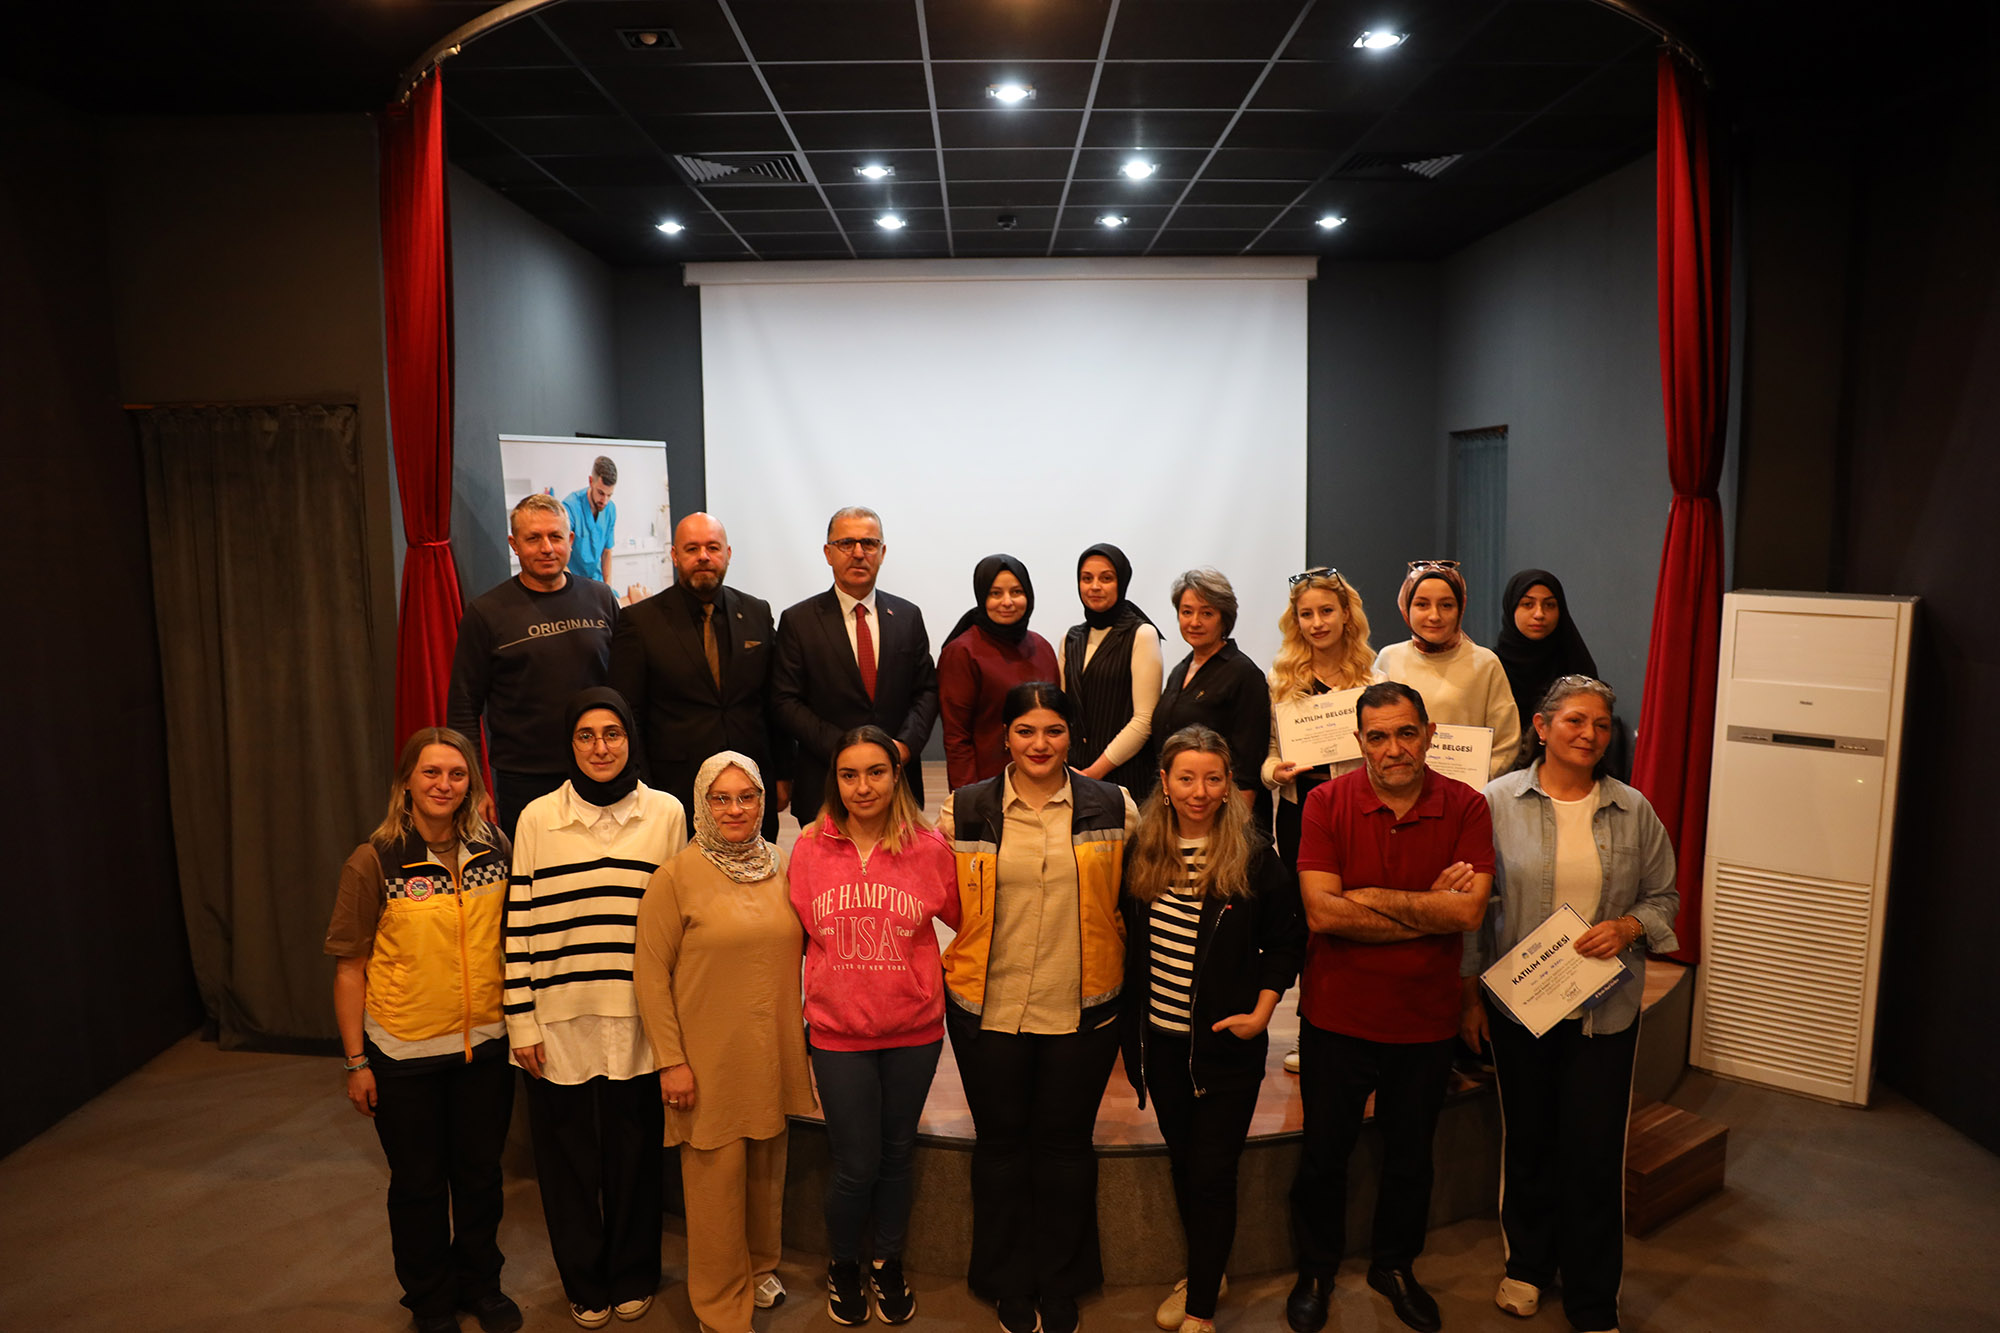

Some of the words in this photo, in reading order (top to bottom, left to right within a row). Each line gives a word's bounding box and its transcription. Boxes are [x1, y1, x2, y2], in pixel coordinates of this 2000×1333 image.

[528, 618, 606, 637] ORIGINALS
[1294, 714, 1323, 725] KATILIM
[1325, 706, 1355, 719] BELGESİ
[1442, 743, 1473, 753] BELGESİ
[811, 888, 836, 927] THE
[838, 882, 925, 927] HAMPTONS
[834, 916, 903, 962] USA
[1511, 959, 1541, 986] KATILIM
[1539, 933, 1570, 962] BELGESİ
